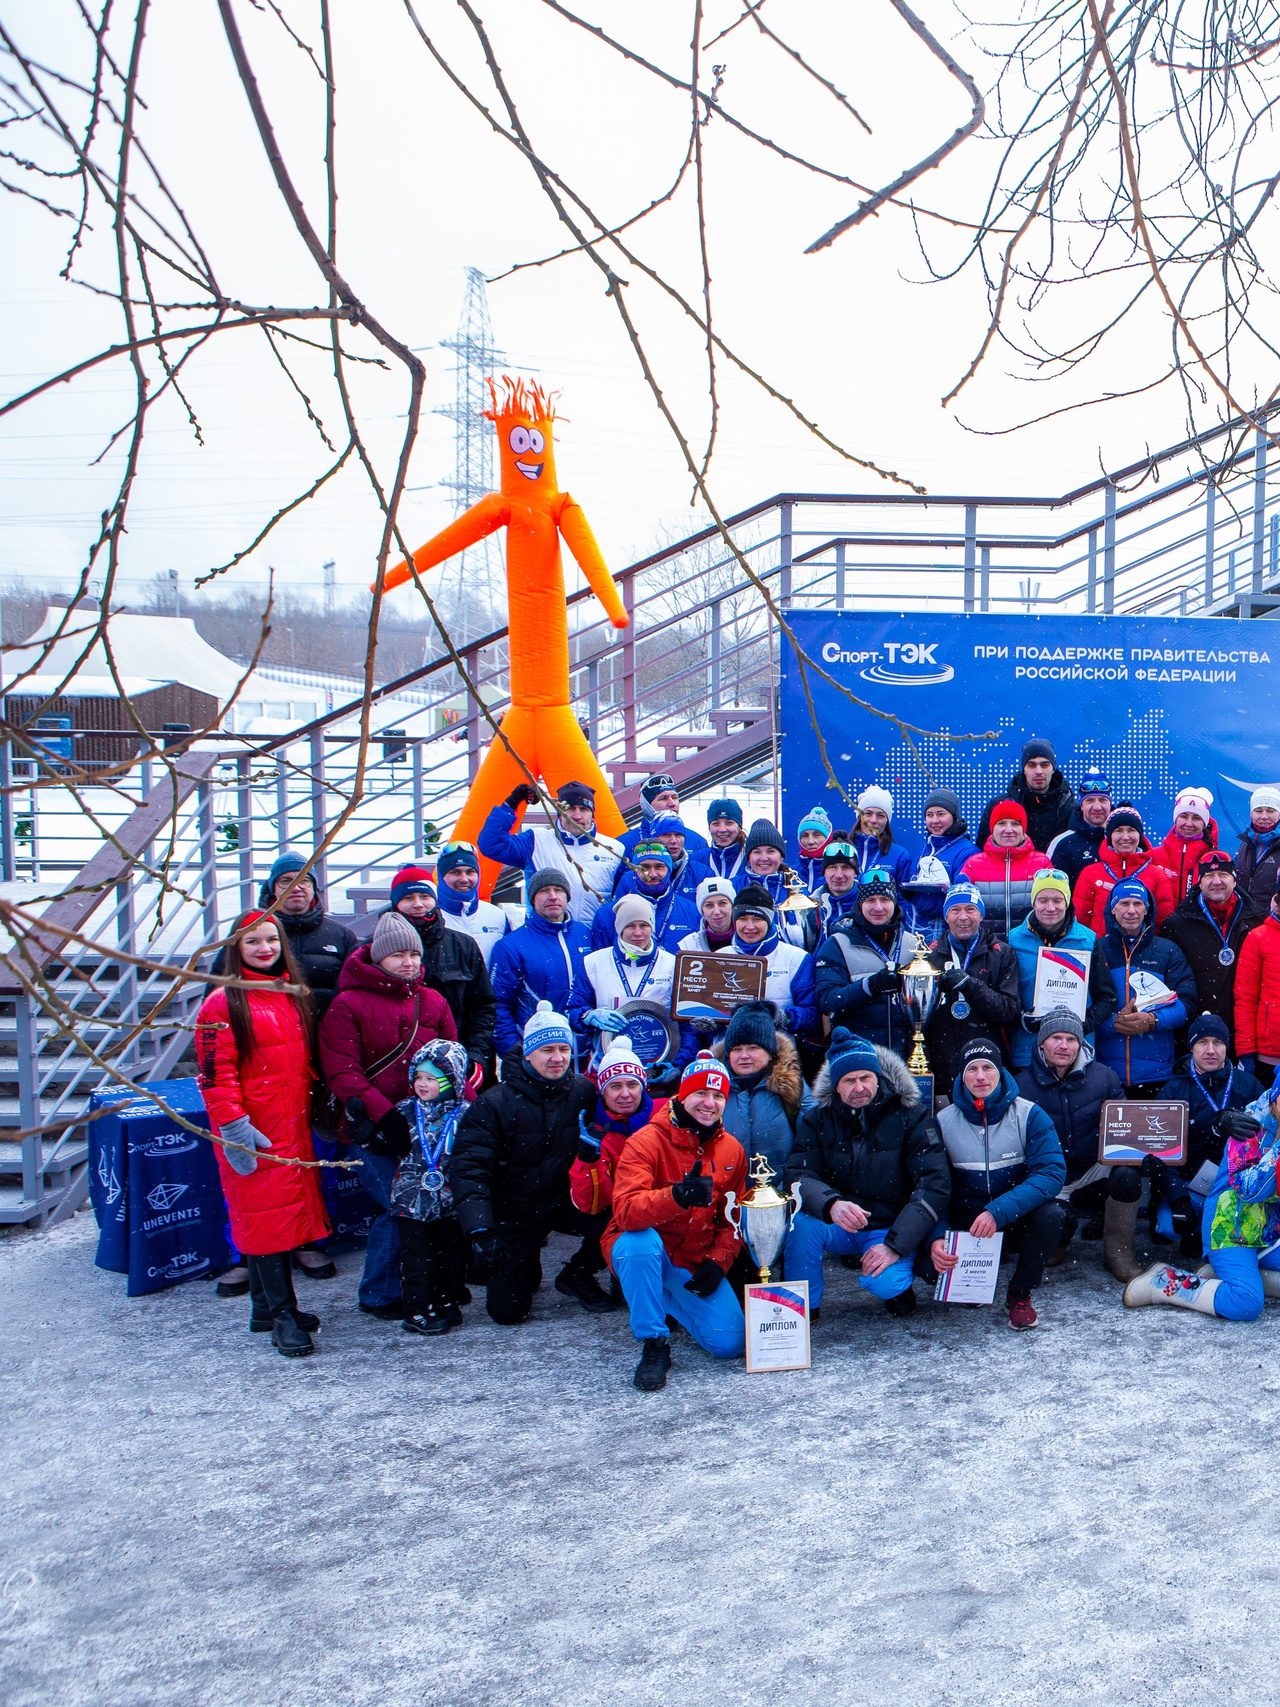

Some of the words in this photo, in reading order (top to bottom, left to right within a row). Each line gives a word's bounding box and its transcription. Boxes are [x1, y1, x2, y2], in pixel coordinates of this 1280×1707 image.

[973, 645, 1009, 659] ПРИ
[1015, 646, 1124, 661] ПОДДЕРЖКЕ
[1130, 648, 1271, 664] ПРАВИТЕЛЬСТВА
[1015, 663, 1129, 681] РОССИЙСКОЙ
[1135, 668, 1237, 684] ФЕДЕРАЦИИ
[690, 960, 704, 976] 2
[1046, 979, 1078, 989] ДИПЛОМ
[528, 1030, 563, 1047] РОССИИ
[598, 1064, 647, 1083] MOSCO
[1116, 1107, 1123, 1121] 1
[142, 1207, 201, 1231] UNEVENTS
[960, 1259, 993, 1268] ДИПЛОМ
[759, 1321, 797, 1333] ДИПЛОМ
